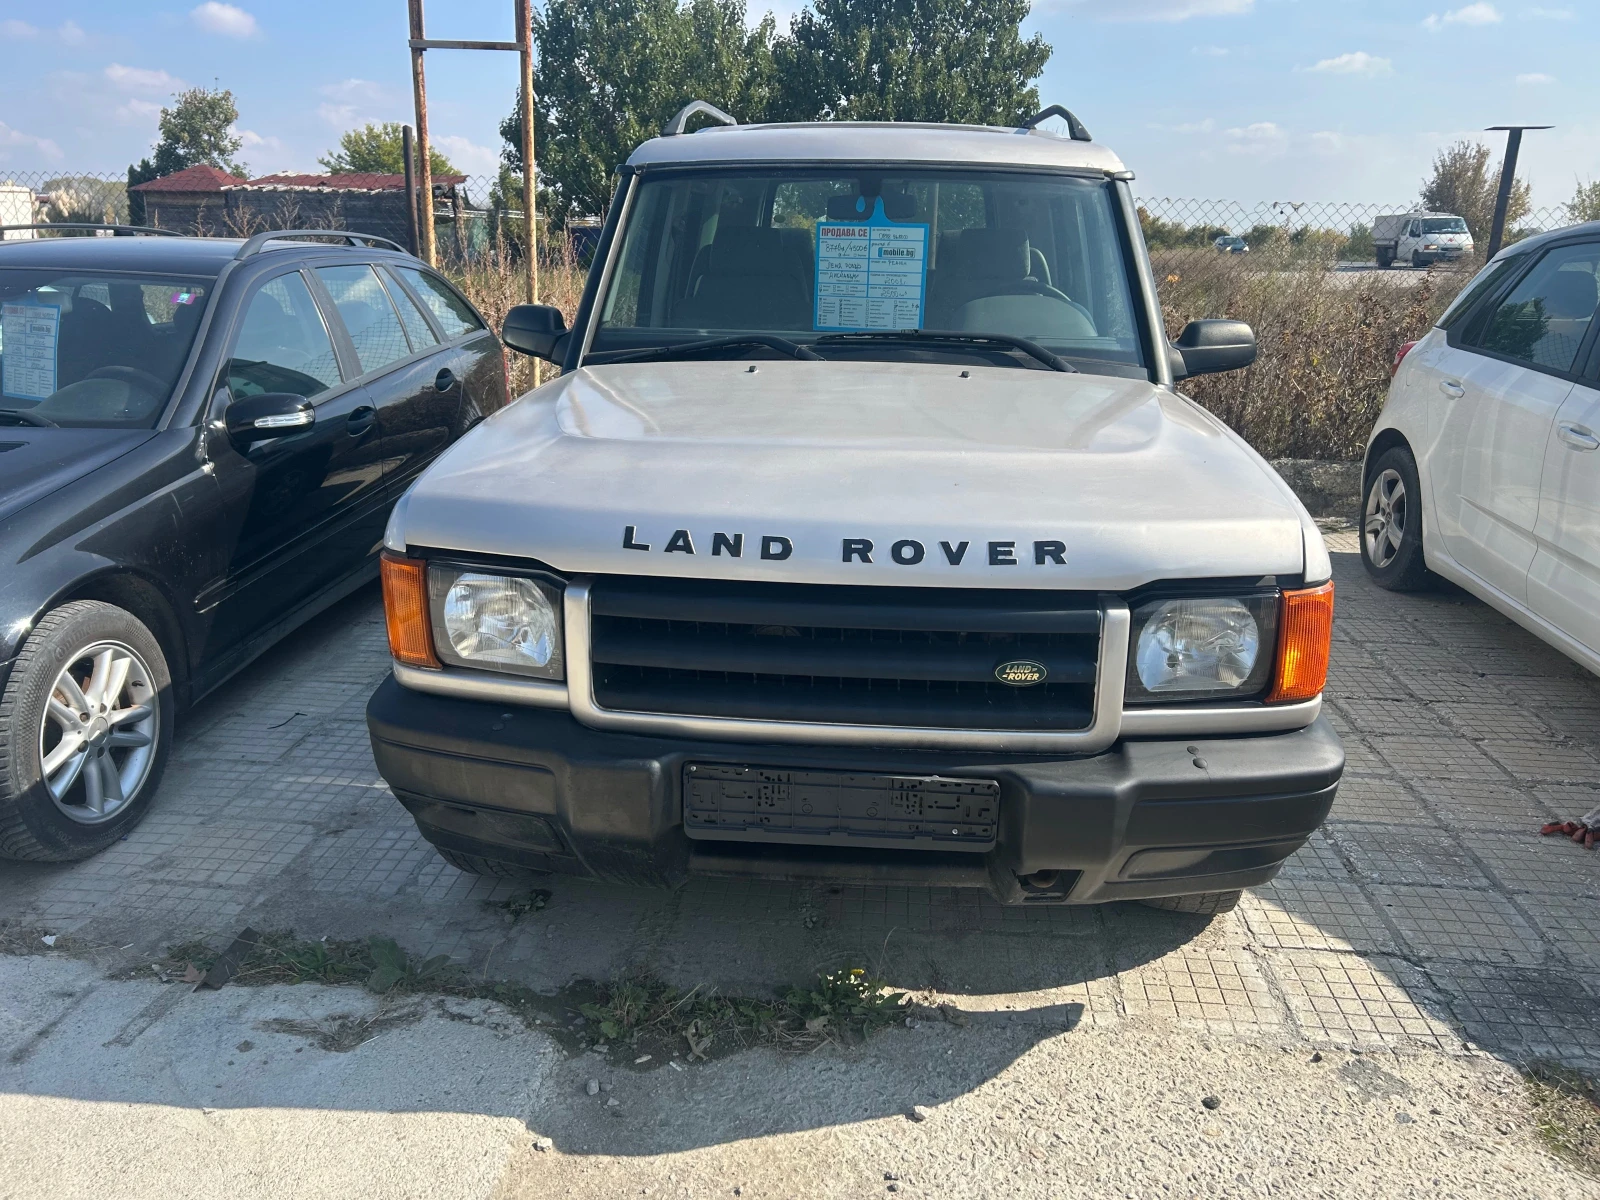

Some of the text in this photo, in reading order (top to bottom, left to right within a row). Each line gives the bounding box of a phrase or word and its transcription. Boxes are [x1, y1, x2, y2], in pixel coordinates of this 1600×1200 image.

[821, 227, 868, 238] ПРОДАВА СЕ
[883, 248, 915, 258] mobile.bg
[622, 525, 1069, 566] LAND ROVER
[1005, 664, 1032, 673] LAND
[1007, 672, 1040, 681] ROVER
